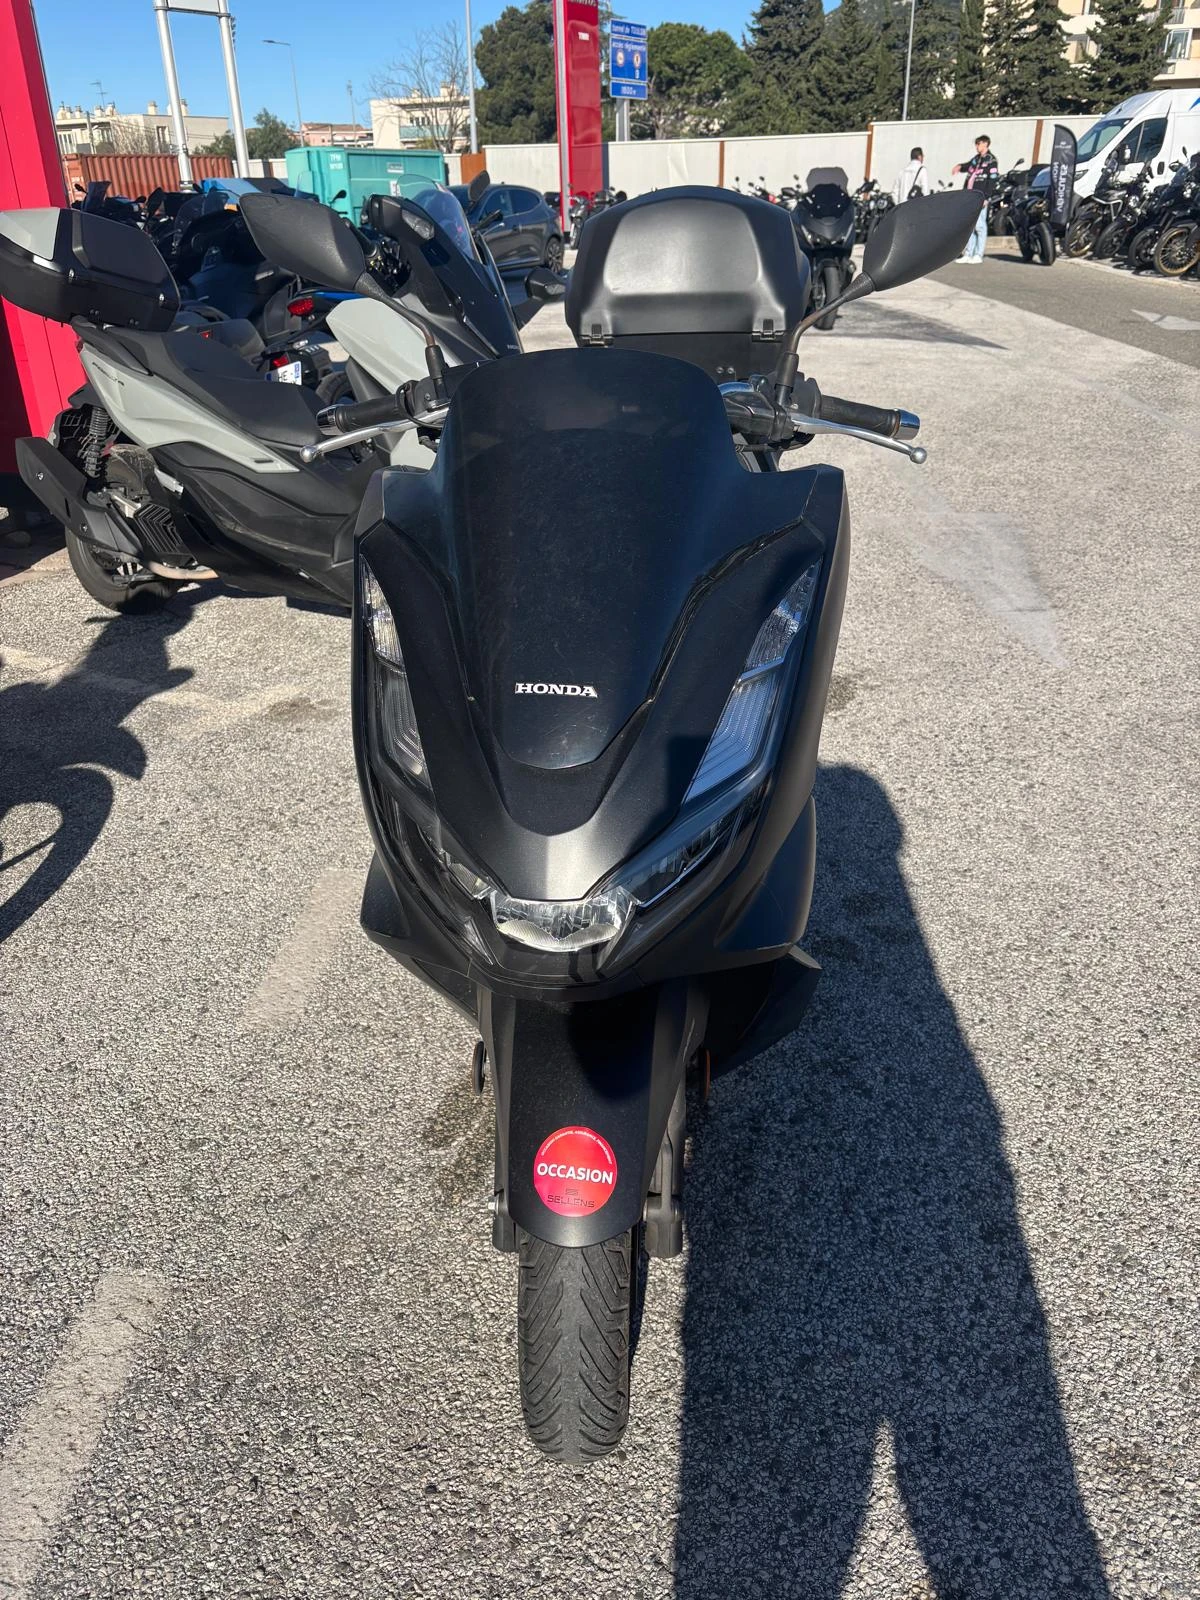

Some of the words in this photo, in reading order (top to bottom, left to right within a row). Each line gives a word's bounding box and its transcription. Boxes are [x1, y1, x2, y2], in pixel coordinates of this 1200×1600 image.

[514, 682, 598, 698] HONDA
[537, 1162, 614, 1185] OCCASION
[547, 1194, 595, 1208] SELLENS
